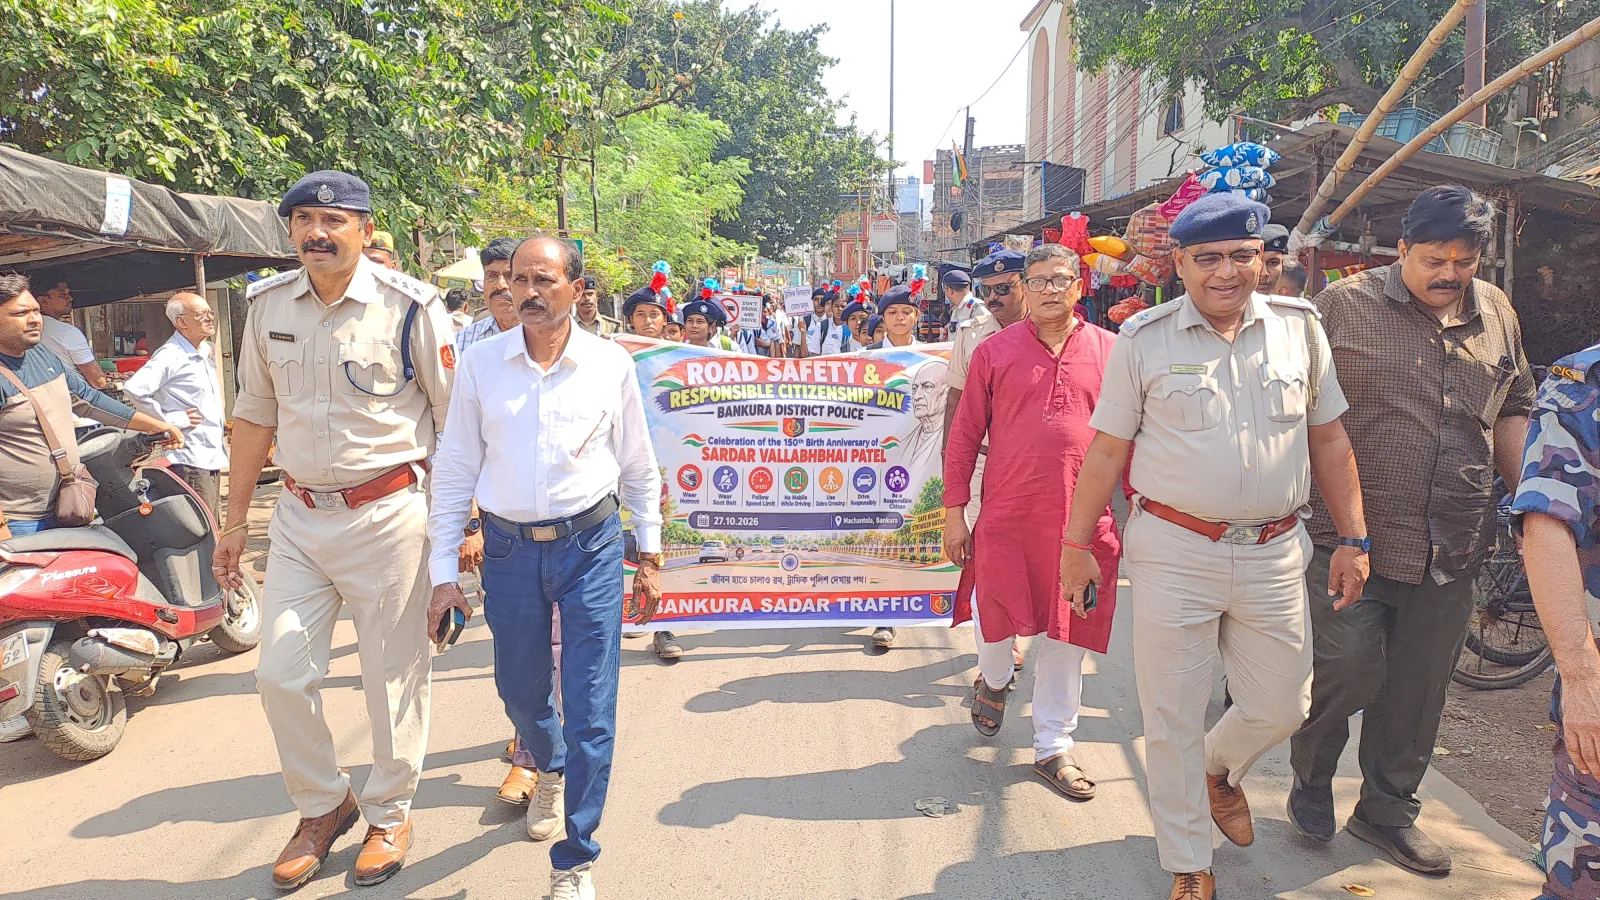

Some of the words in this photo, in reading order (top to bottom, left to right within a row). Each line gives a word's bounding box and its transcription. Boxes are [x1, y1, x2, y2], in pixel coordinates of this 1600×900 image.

[686, 360, 759, 386] ROAD
[766, 360, 858, 384] SAFETY
[863, 363, 881, 385] &
[669, 384, 775, 409] RESPONSIBLE
[778, 383, 875, 404] CITIZENSHIP
[877, 389, 906, 410] DAY
[717, 404, 773, 419] BANKURA
[775, 404, 825, 417] DISTRICT
[827, 405, 865, 421] POLICE
[708, 436, 755, 446] Celebration
[757, 436, 767, 446] of
[768, 437, 781, 447] the
[805, 438, 824, 447] Birth
[826, 437, 870, 449] Anniversary
[871, 437, 879, 447] of
[701, 446, 756, 463] SARDAR
[759, 447, 848, 463] VALLABHBHAI
[851, 448, 887, 463] PATEL
[745, 500, 762, 508] Speed
[751, 493, 769, 501] Follow
[850, 499, 877, 507] Responsibly
[713, 516, 759, 526] 27.10.2026
[843, 516, 874, 524] Machantola,
[40, 566, 97, 587] Pleasure
[710, 573, 730, 584] জীবন
[732, 575, 748, 584] হাতে
[749, 575, 771, 585] চালাও
[787, 574, 808, 586] ট্রাফিক
[810, 573, 829, 588] পুলিশ
[760, 597, 831, 613] SADAR
[836, 596, 924, 613] TRAFFIC
